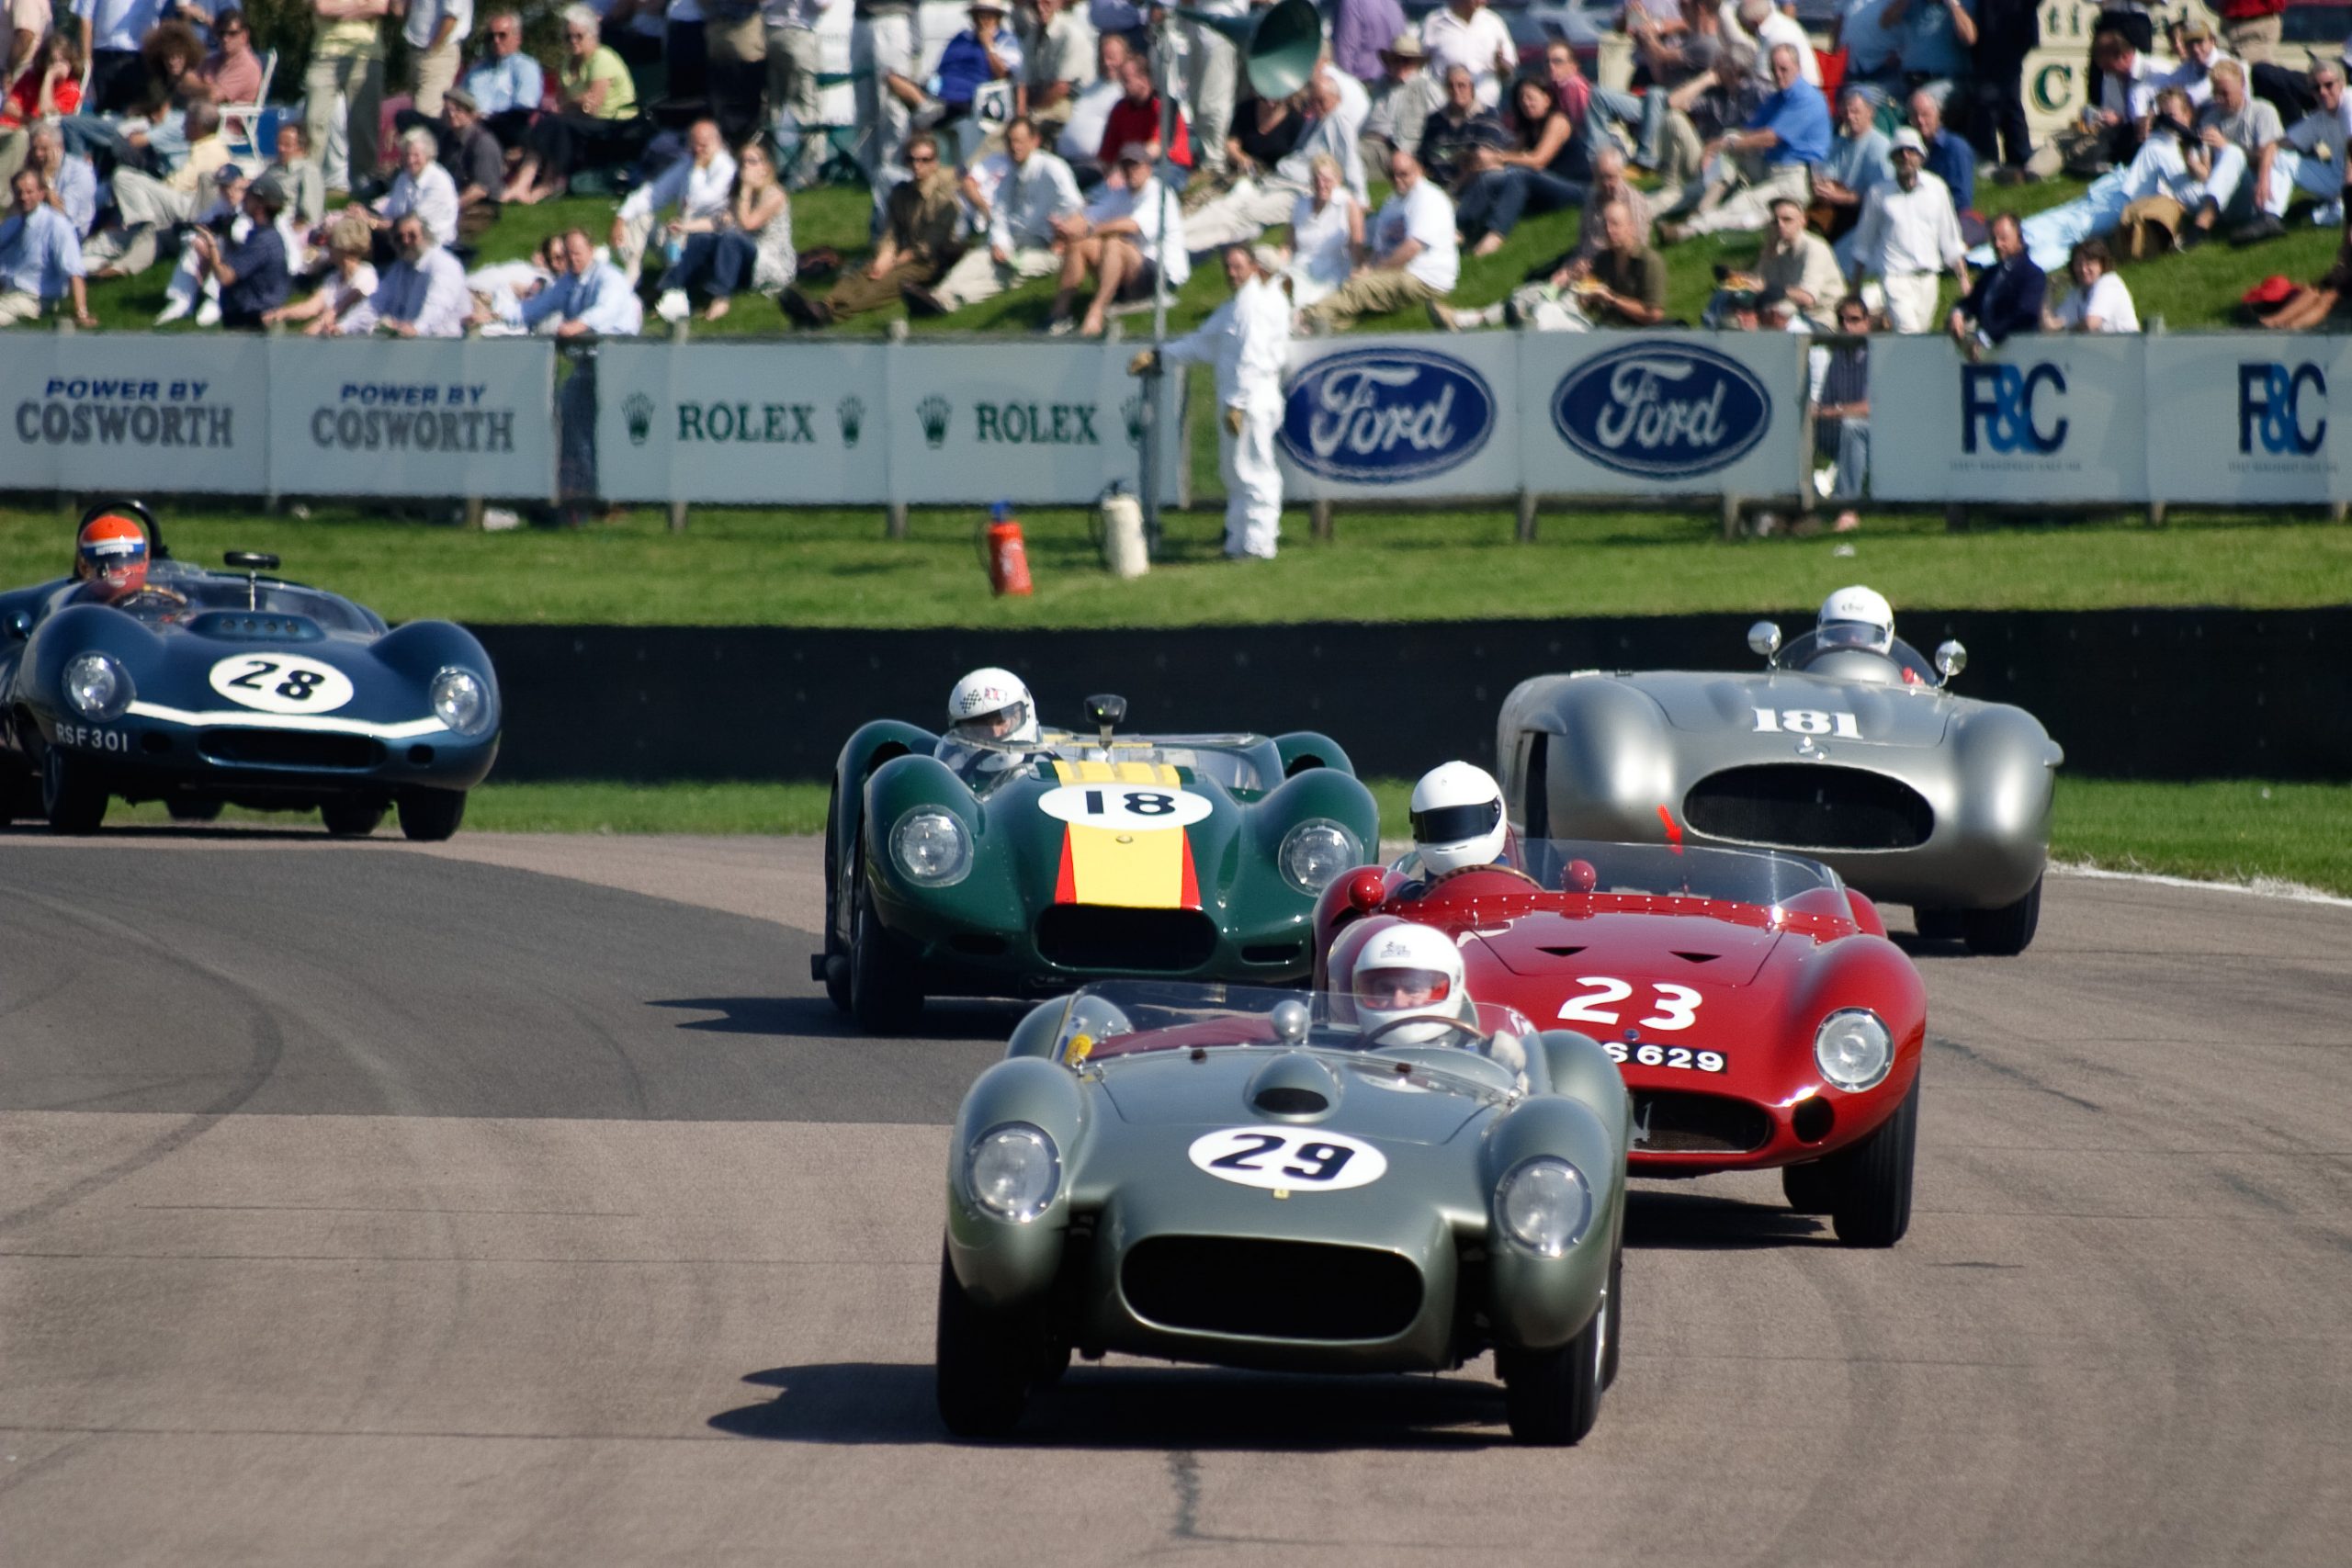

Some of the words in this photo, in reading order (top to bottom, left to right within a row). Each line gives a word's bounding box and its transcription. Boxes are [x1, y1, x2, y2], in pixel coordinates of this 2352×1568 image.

[46, 379, 160, 401] POWER
[169, 380, 209, 401] BY
[340, 383, 438, 406] POWER
[447, 384, 487, 406] BY
[1309, 367, 1455, 457] Ford
[1596, 360, 1728, 448] Ford
[1961, 362, 2070, 455] F&C
[2238, 363, 2328, 456] F&C
[16, 401, 233, 448] COSWORTH
[311, 407, 515, 453] COSWORTH
[677, 401, 815, 444] ROLEX
[975, 402, 1100, 445] ROLEX
[228, 660, 325, 701] 28
[1750, 705, 1863, 739] 181
[1085, 790, 1176, 817] 18
[1557, 976, 1703, 1031] 23
[1209, 1134, 1355, 1181] 29
